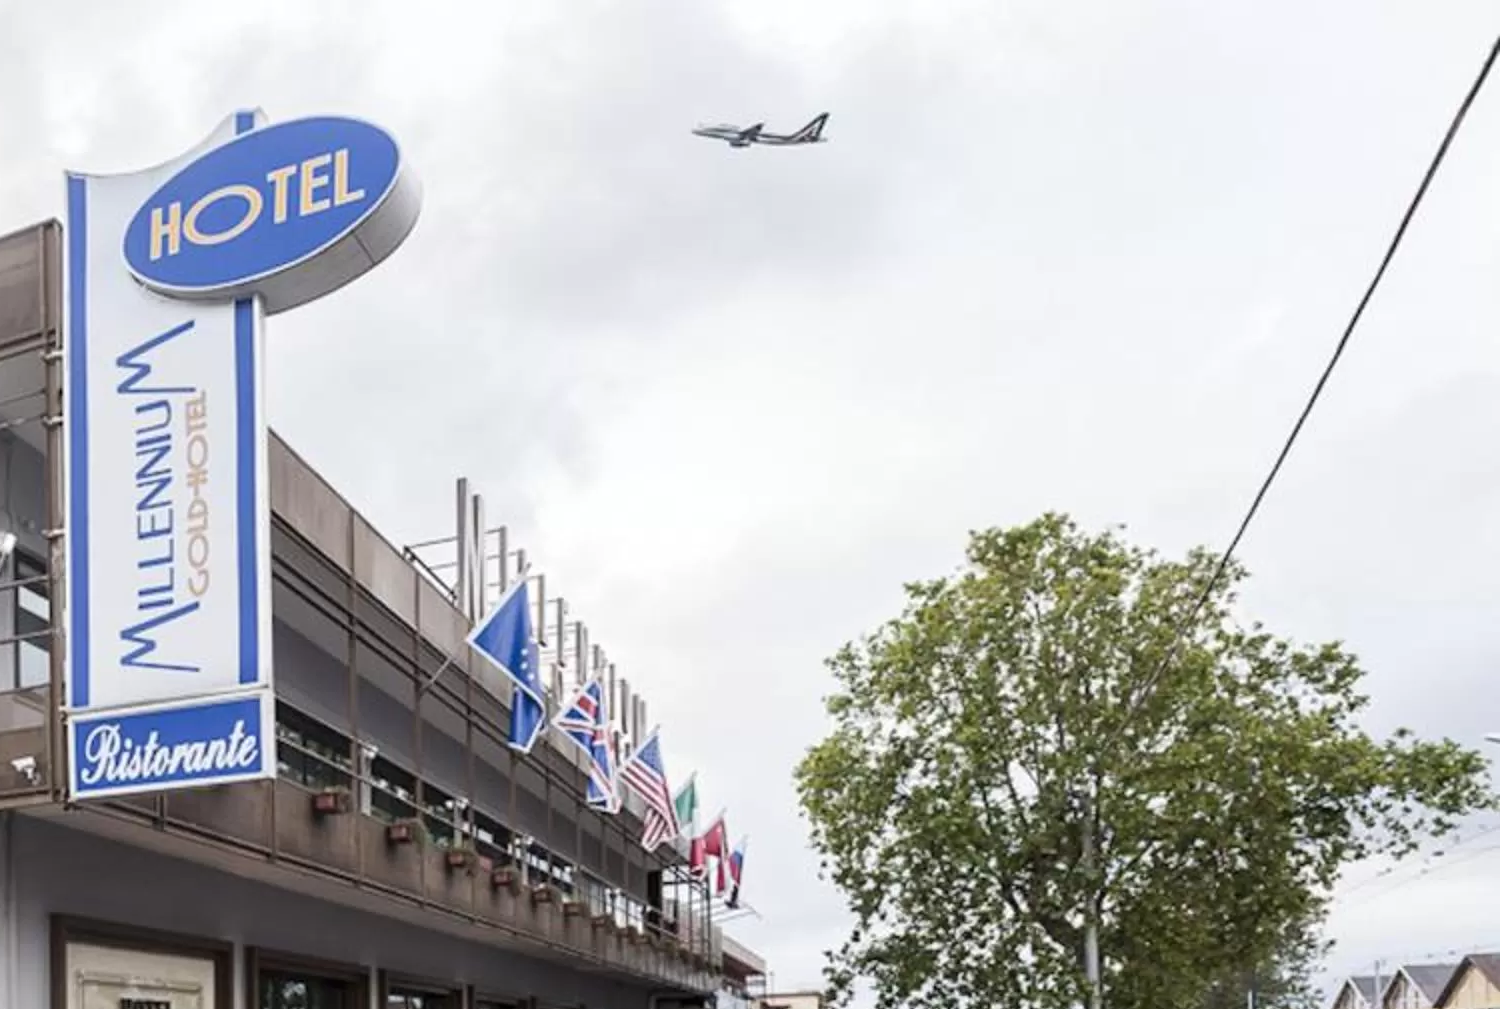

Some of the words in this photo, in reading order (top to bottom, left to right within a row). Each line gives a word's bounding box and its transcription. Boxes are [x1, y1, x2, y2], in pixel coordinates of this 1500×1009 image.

[150, 147, 365, 262] HOTEL
[115, 319, 200, 673] MILLENNIUM
[81, 719, 259, 784] Ristorante
